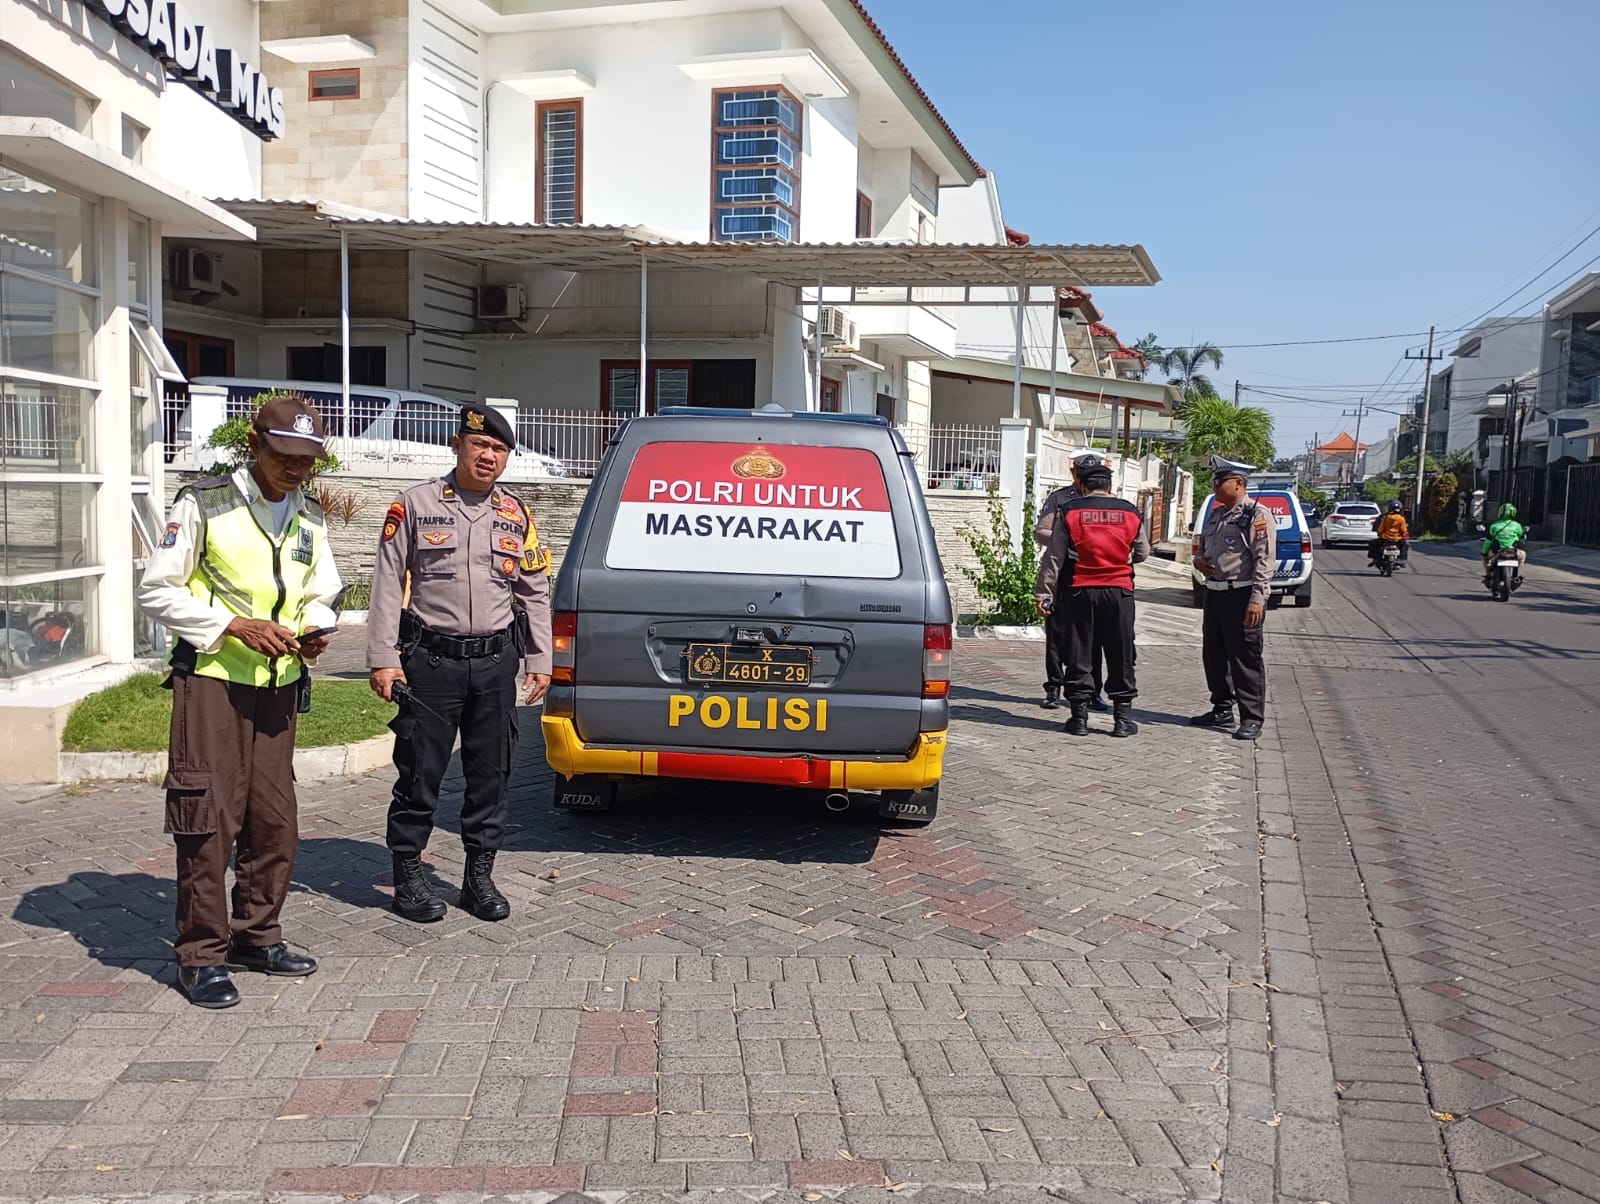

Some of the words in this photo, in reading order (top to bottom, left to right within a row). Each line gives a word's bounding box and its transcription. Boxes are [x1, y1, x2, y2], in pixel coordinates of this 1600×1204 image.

[103, 0, 220, 93] SADA
[230, 49, 285, 139] MAS
[648, 479, 744, 503] POLRI
[753, 483, 863, 509] UNTUK
[645, 512, 864, 543] MASYARAKAT
[1082, 511, 1124, 523] POLISI
[762, 649, 774, 662] X
[669, 694, 828, 732] POLISI
[560, 793, 602, 806] KUDA
[887, 801, 928, 815] KUDA
